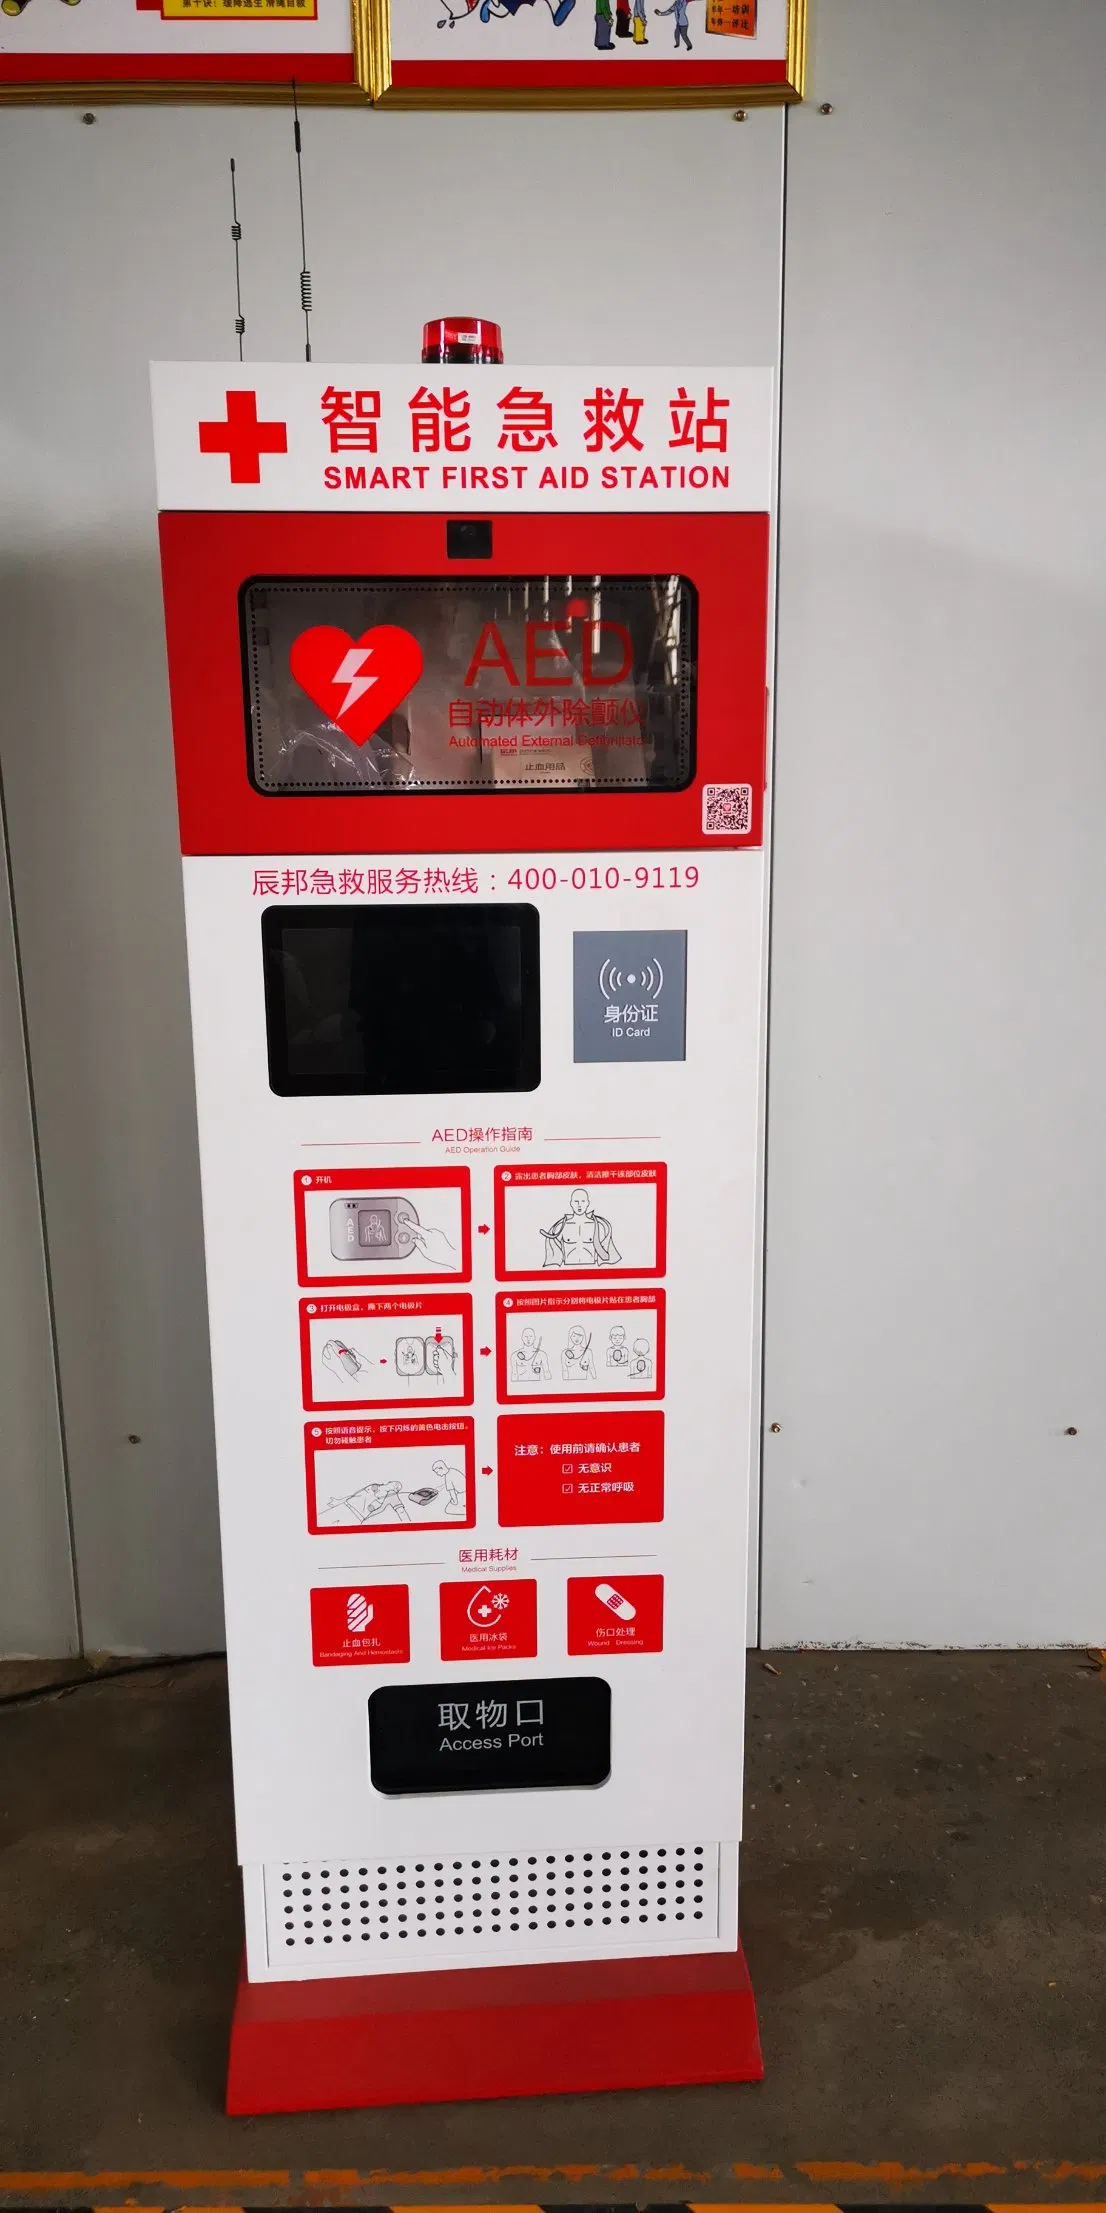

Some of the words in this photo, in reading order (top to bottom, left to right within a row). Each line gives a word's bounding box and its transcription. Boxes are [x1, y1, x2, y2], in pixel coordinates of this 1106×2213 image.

[321, 386, 729, 453] 智能急救站
[324, 466, 429, 489] SMART
[443, 466, 528, 489] FIRST
[539, 467, 588, 488] AID
[602, 466, 729, 488] STATION
[465, 621, 634, 686] AED
[448, 698, 645, 728] 自动体外除颤仪
[449, 735, 518, 747] Automated
[522, 734, 574, 747] External
[604, 1004, 658, 1023] 身份证
[612, 1027, 624, 1038] ID
[625, 1026, 651, 1038] Card
[432, 1127, 532, 1142] AED操作指南
[445, 1146, 462, 1154] AED
[462, 1146, 498, 1155] Operation
[499, 1145, 521, 1153] Guide
[315, 1175, 333, 1184] 开机
[577, 1462, 613, 1474] 无意识
[577, 1481, 635, 1494] 无正常呼吸
[459, 1548, 518, 1562] 医用耗材
[488, 1564, 517, 1573] Supplies
[469, 1632, 508, 1643] 医用冰袋
[595, 1626, 636, 1638] 伤口处理
[342, 1637, 381, 1648] 止血包扎
[438, 1700, 543, 1731] 取物口
[439, 1737, 503, 1752] Access
[509, 1733, 543, 1747] Port
